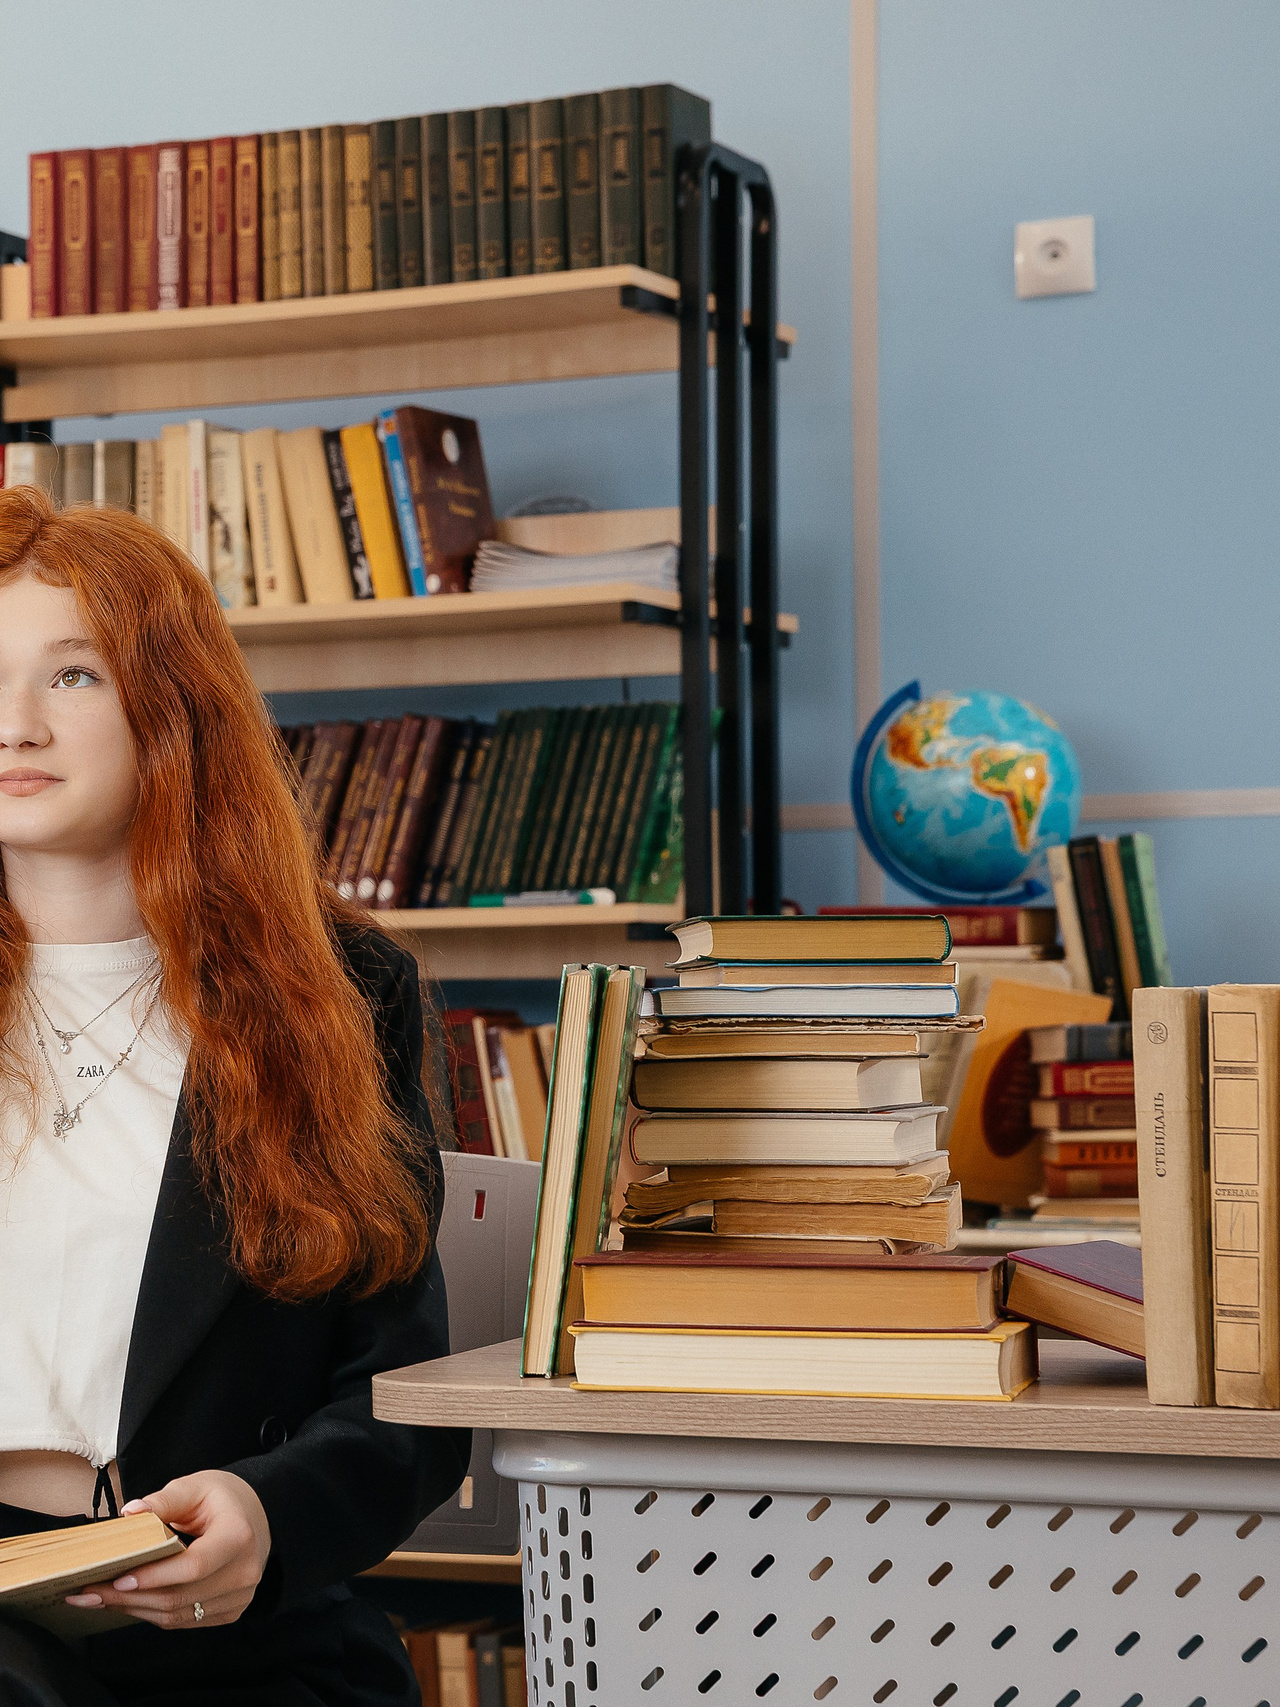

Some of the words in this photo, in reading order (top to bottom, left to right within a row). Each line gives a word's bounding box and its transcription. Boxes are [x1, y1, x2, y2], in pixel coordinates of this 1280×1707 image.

[76, 1064, 106, 1079] ZARA
[1154, 1092, 1167, 1178] СТЕНДАЛЬ
[1214, 1188, 1260, 1198] СТЕНДАЛЬ
